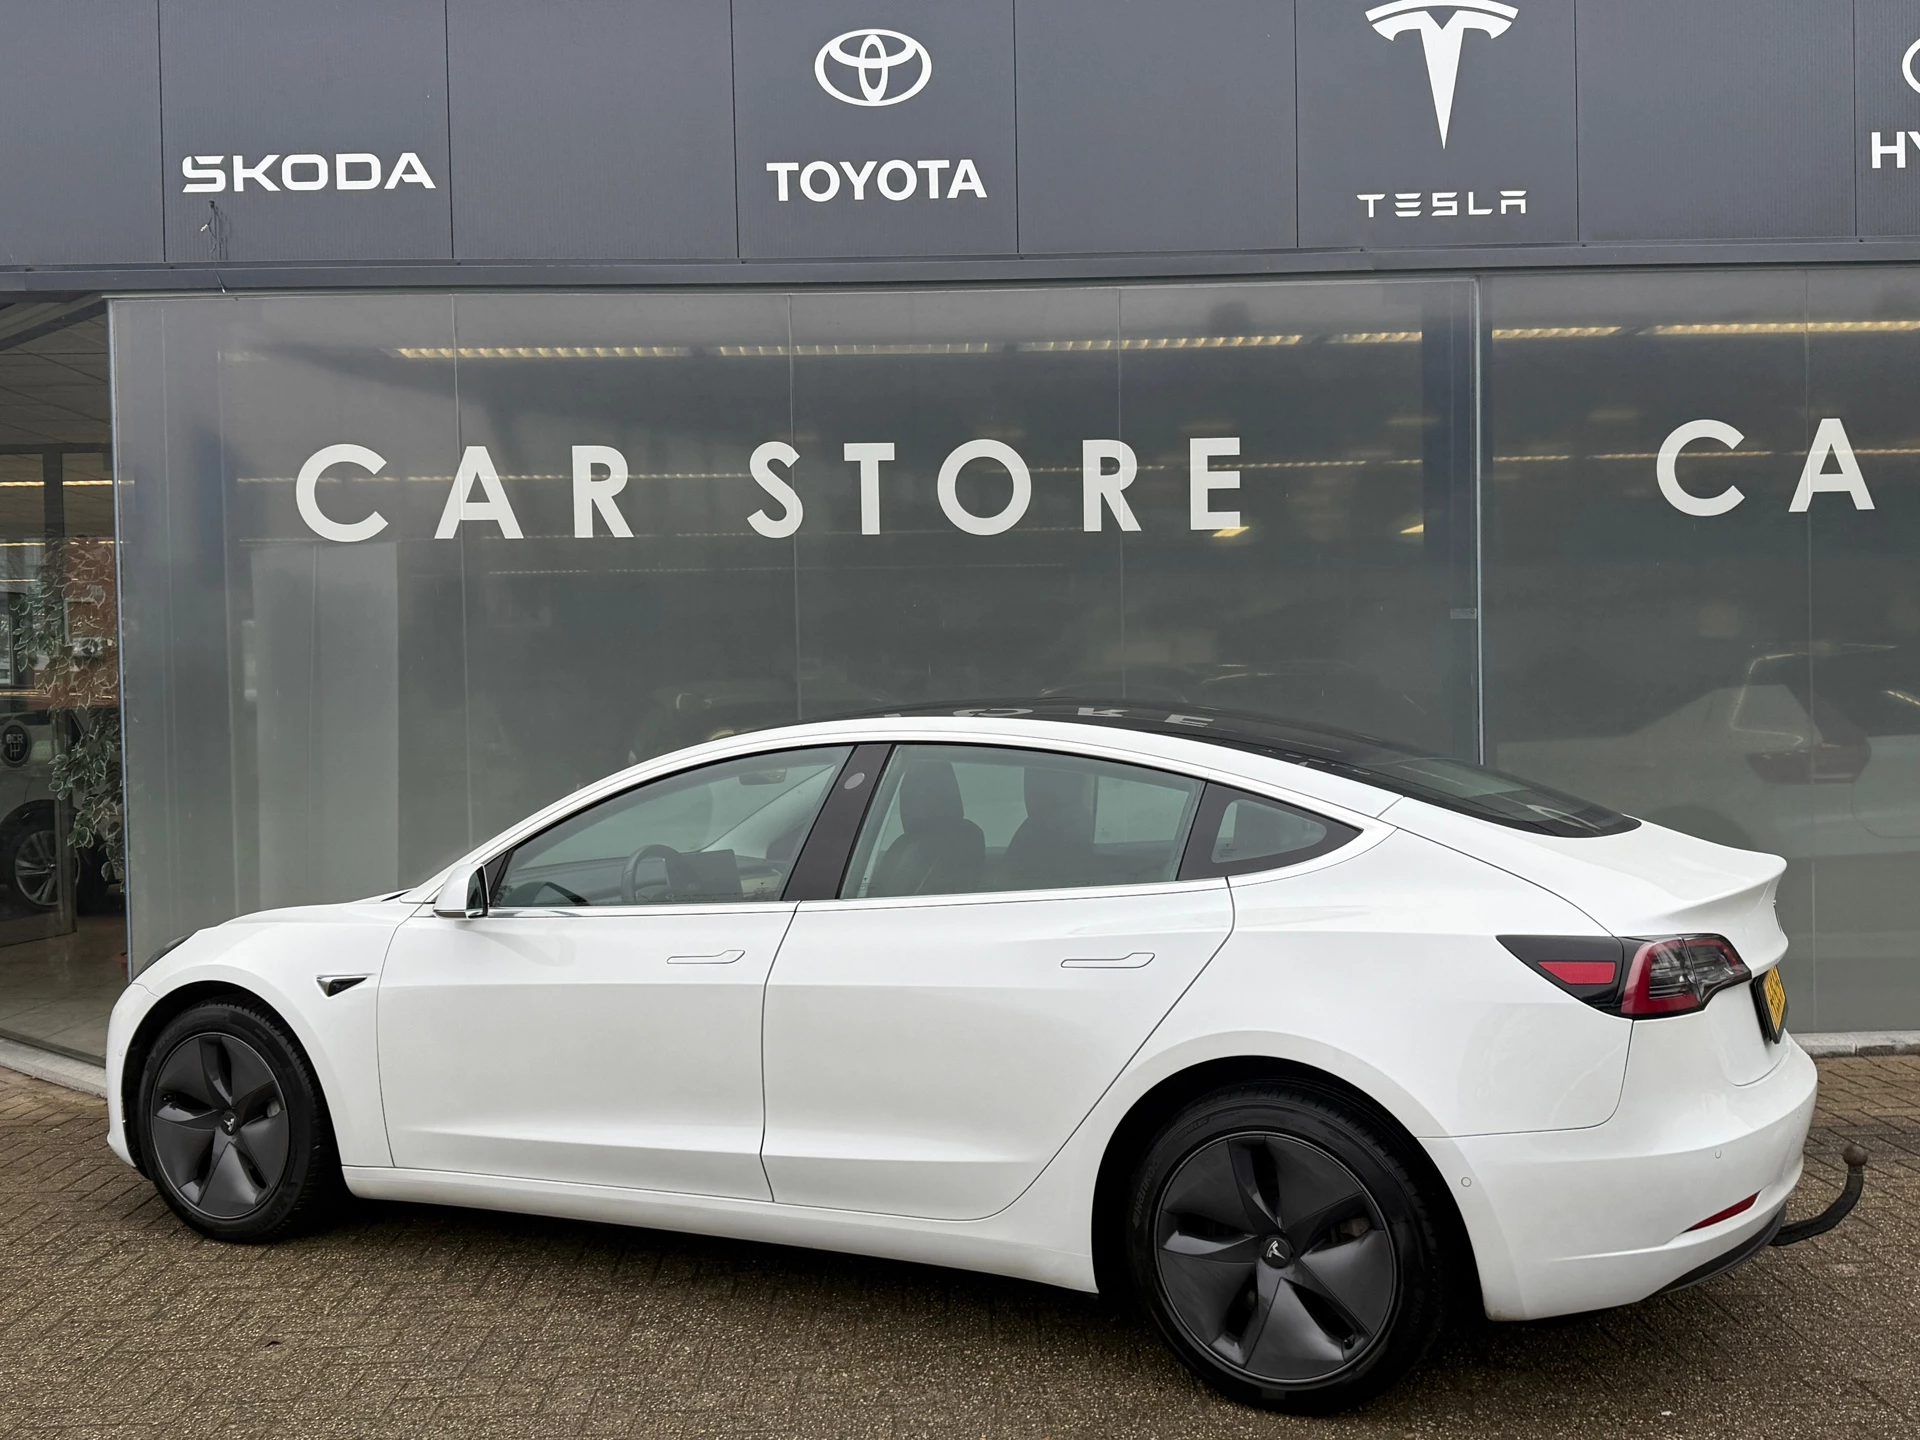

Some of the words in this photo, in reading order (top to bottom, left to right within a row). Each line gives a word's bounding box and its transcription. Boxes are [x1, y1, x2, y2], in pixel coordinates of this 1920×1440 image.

[182, 152, 436, 193] SKODA
[766, 159, 987, 202] TOYOTA
[1356, 190, 1527, 218] TESLA
[1656, 418, 1876, 517] CA
[295, 443, 635, 543] CAR
[746, 437, 1249, 539] STORE
